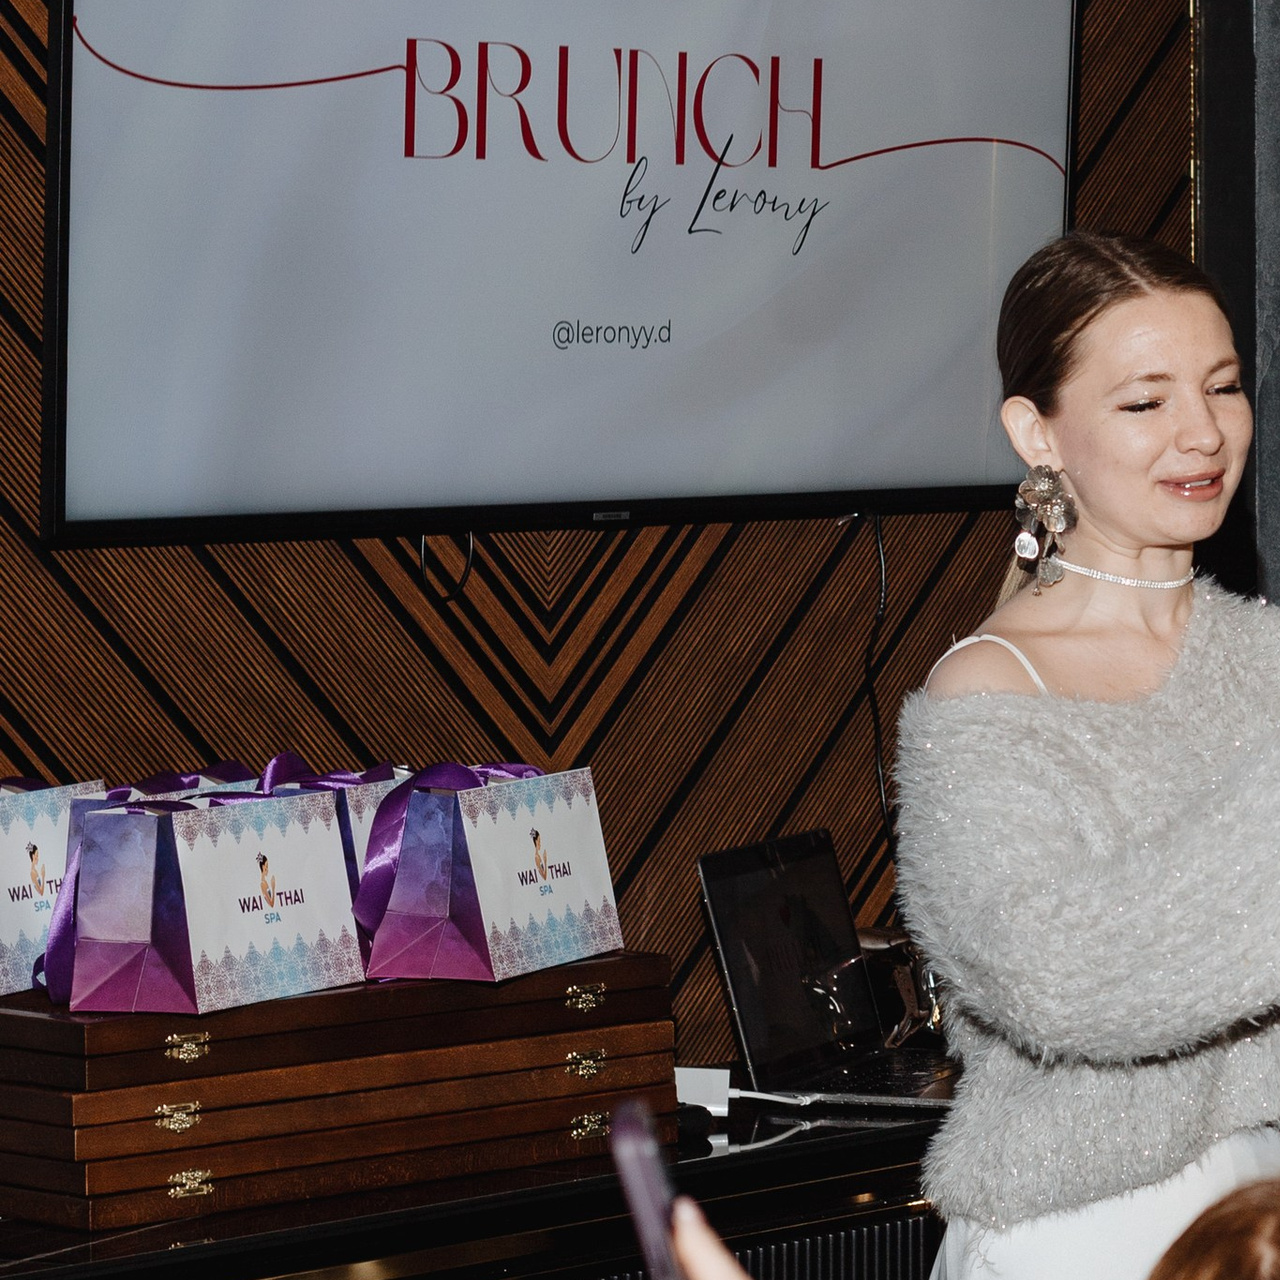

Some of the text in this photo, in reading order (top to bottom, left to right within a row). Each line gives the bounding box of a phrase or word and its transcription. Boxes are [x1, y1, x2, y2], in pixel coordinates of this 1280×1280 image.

[404, 37, 824, 170] BRUNCH
[620, 133, 830, 255] by Lerony
[552, 319, 671, 350] @leronyy.d
[517, 861, 571, 886] WAI THAI
[8, 884, 33, 902] WAI
[238, 888, 304, 914] WAI THAI
[539, 884, 553, 896] SPA
[34, 900, 51, 912] SPA
[264, 912, 281, 924] SPA
